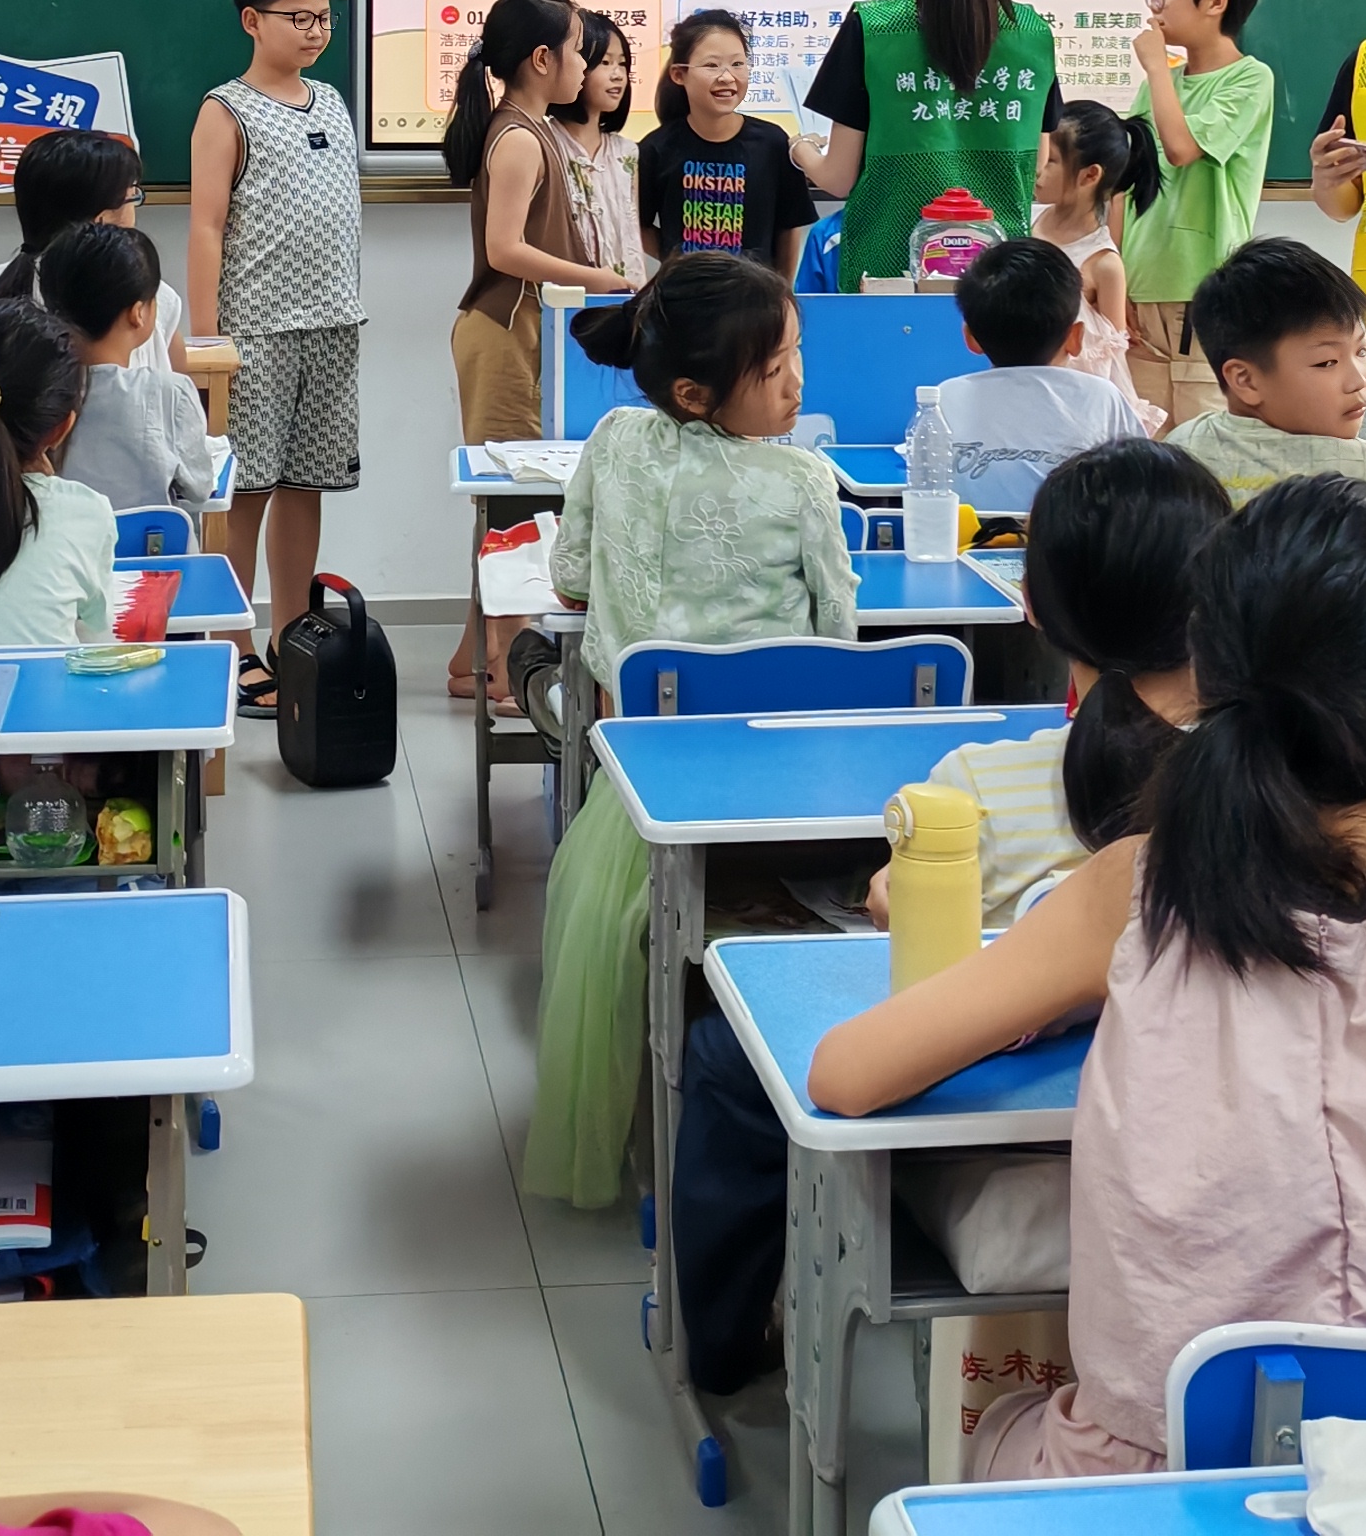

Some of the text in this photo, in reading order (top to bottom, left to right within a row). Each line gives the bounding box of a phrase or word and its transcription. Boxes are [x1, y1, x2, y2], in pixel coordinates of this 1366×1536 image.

[895, 66, 1036, 93] 湖南学院
[683, 160, 746, 179] OKSTAR
[682, 174, 746, 193] OKSTAR
[682, 200, 744, 219] OKSTAR
[682, 213, 744, 233] OKSTAR
[682, 227, 743, 247] OKSTAR
